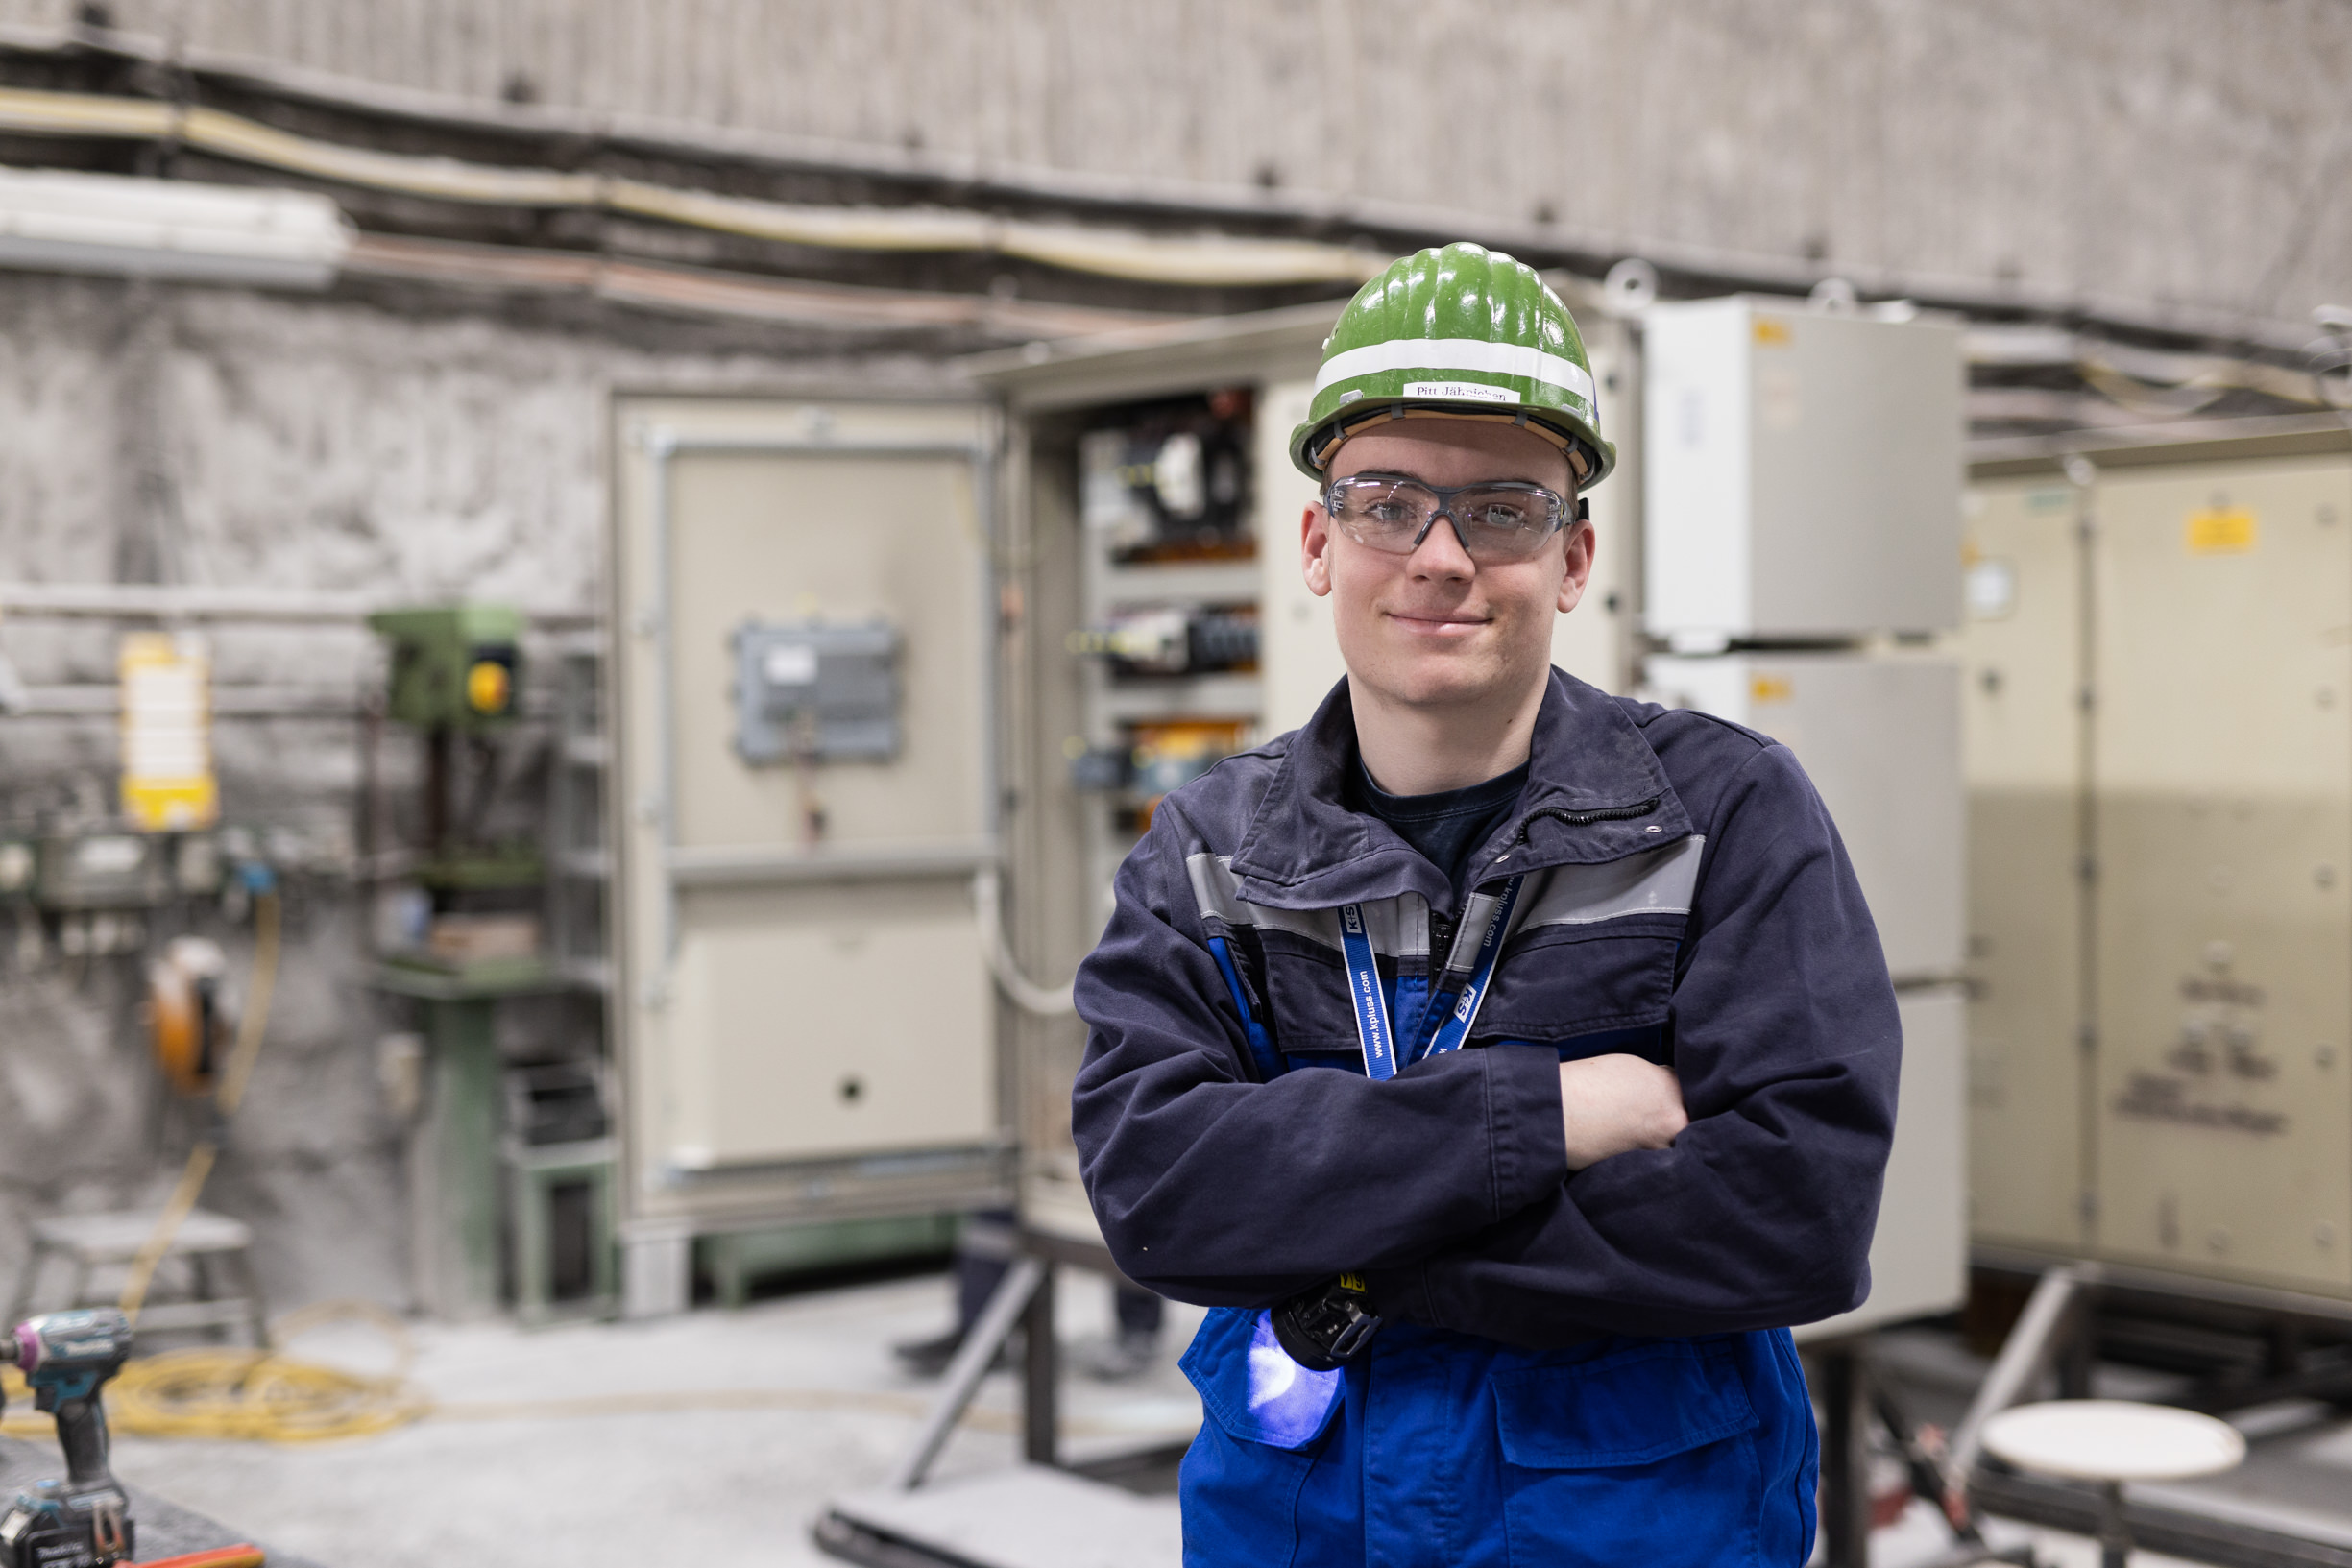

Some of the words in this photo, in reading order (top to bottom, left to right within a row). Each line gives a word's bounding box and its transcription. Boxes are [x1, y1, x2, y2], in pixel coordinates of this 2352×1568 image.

[1418, 386, 1437, 396] Pitt
[1359, 970, 1383, 1058] www.kpluss.com
[1457, 988, 1473, 1018] K+S
